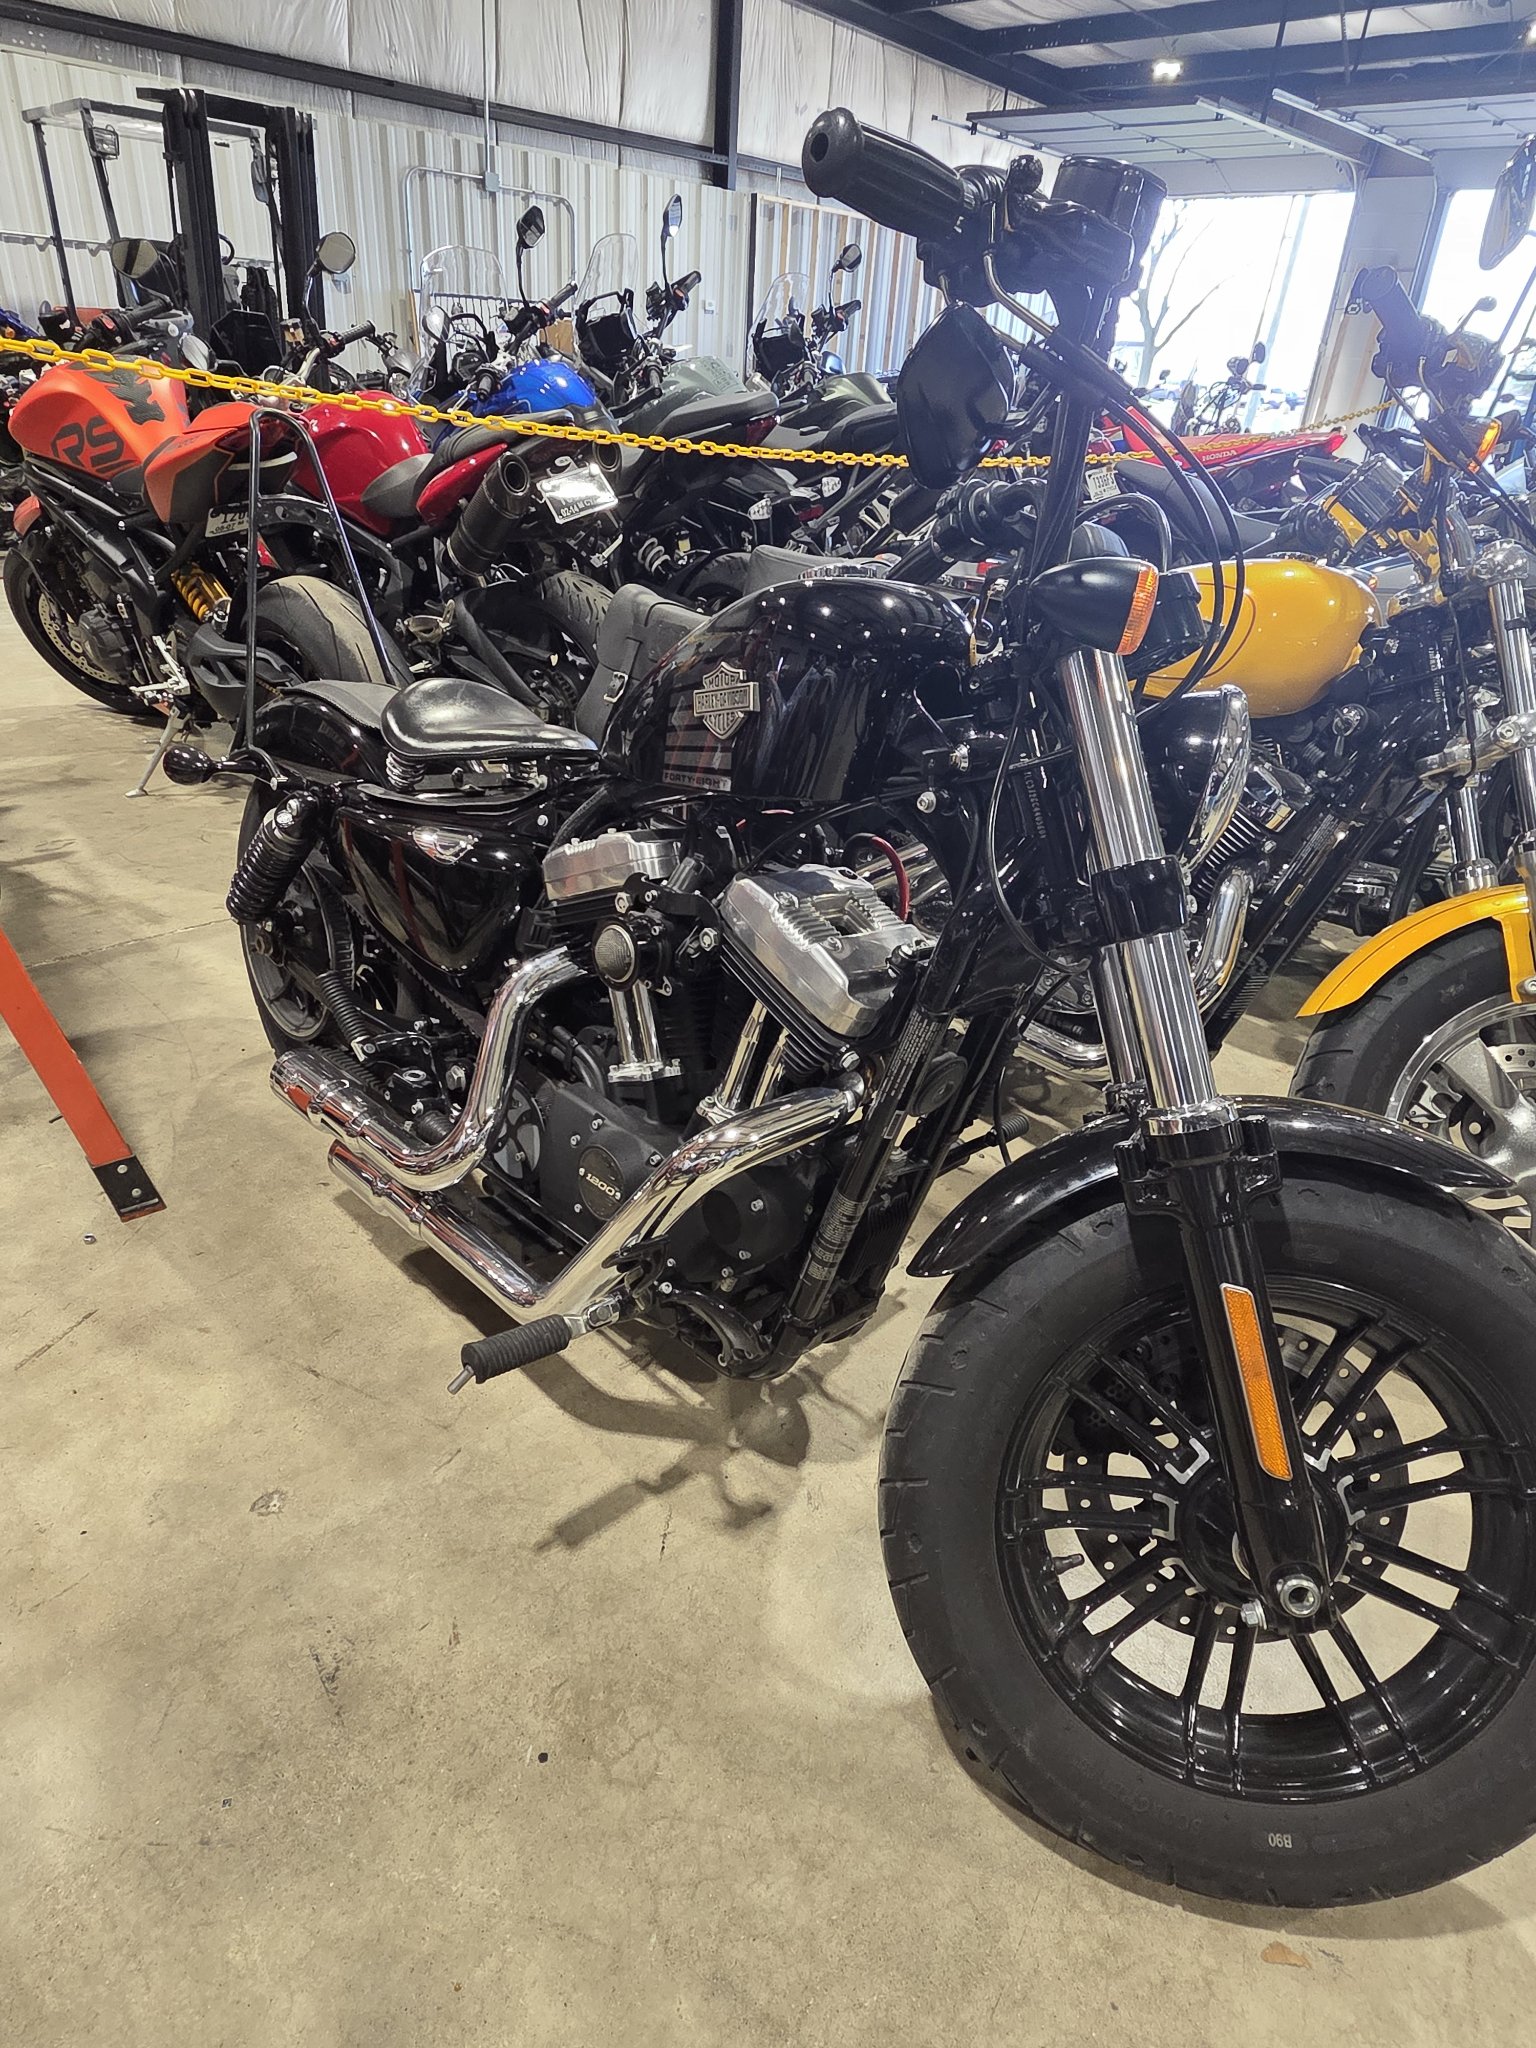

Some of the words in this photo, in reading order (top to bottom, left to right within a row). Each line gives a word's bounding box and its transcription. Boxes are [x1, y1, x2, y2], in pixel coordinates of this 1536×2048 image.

[50, 415, 124, 468] RS
[1202, 450, 1237, 462] HONDA
[706, 672, 740, 688] MOTOR
[697, 689, 748, 710] HARLEY-DAVIDSON
[707, 711, 737, 732] CYCLES
[585, 1172, 615, 1197] 1200
[1268, 1832, 1293, 1849] B90
